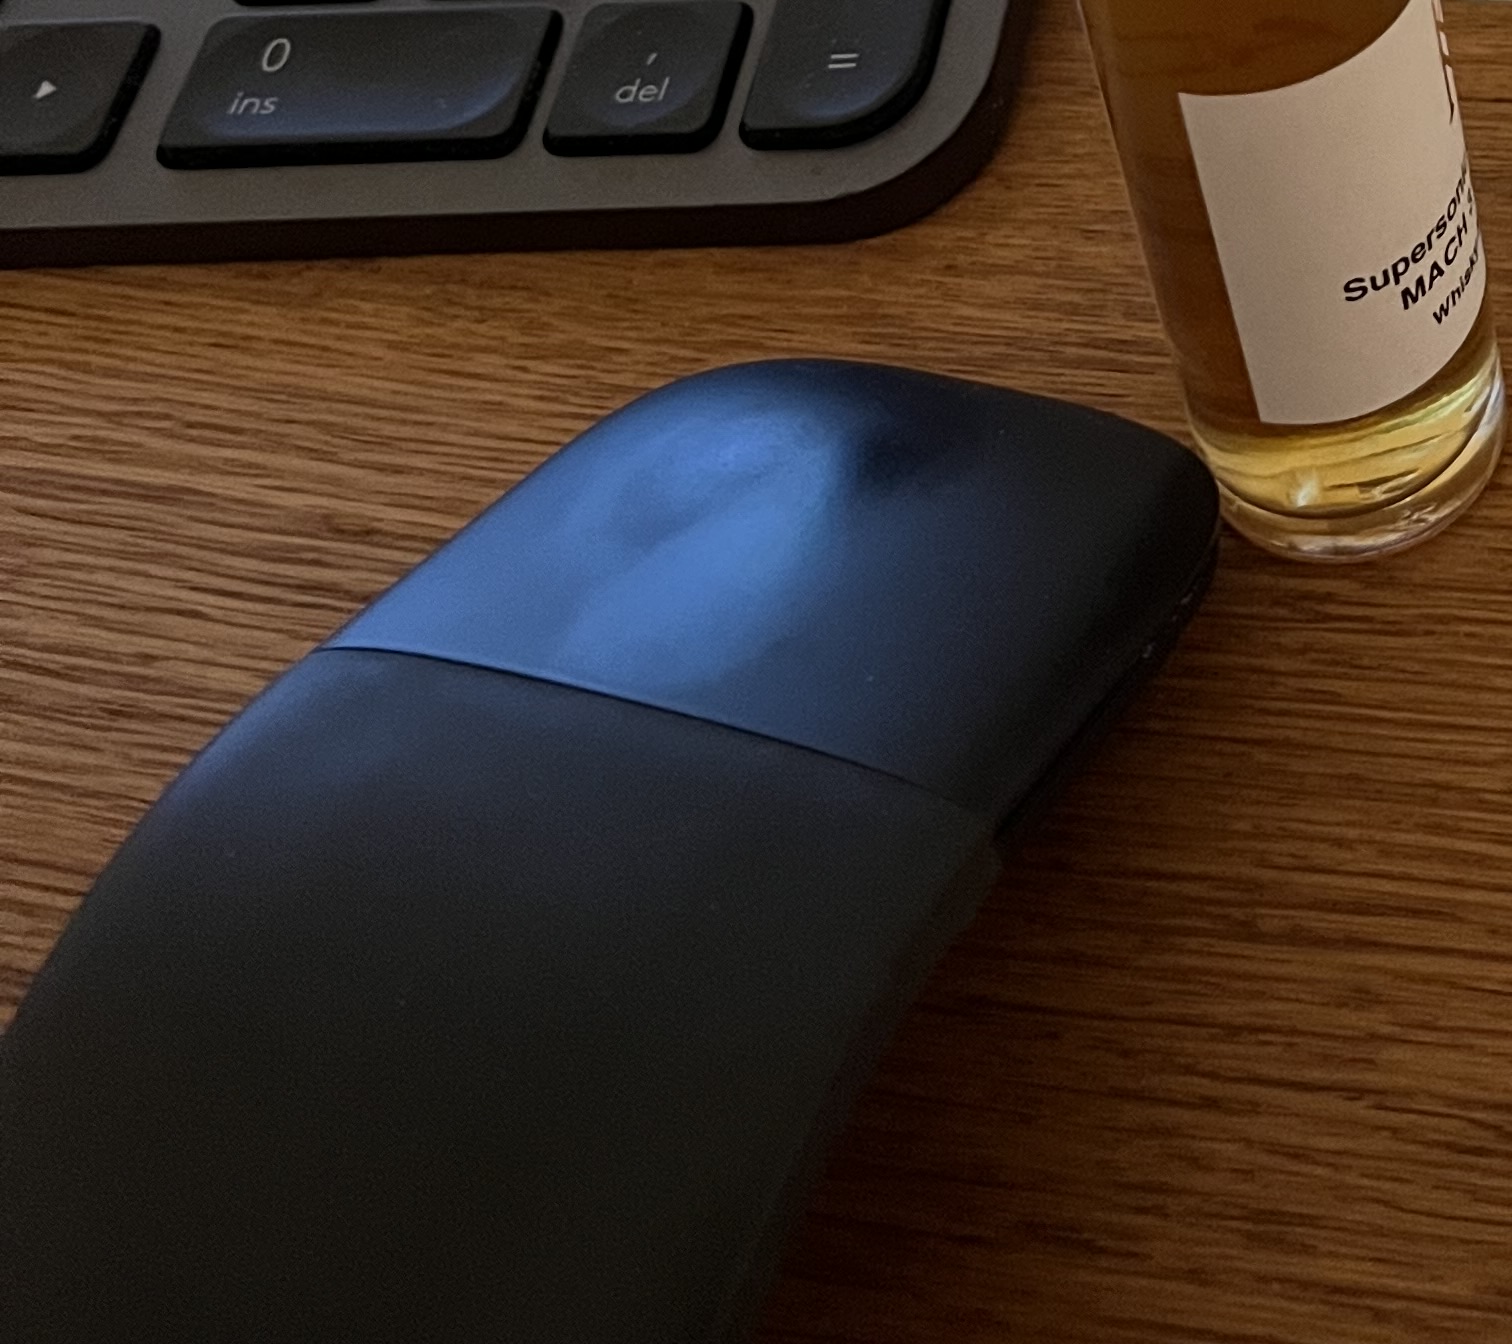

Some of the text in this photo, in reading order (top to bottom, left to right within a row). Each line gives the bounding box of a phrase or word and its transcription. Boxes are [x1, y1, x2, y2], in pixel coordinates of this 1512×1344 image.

[260, 37, 292, 73] 0
[227, 90, 279, 116] ins
[614, 76, 671, 104] del
[1400, 211, 1469, 311] MACH
